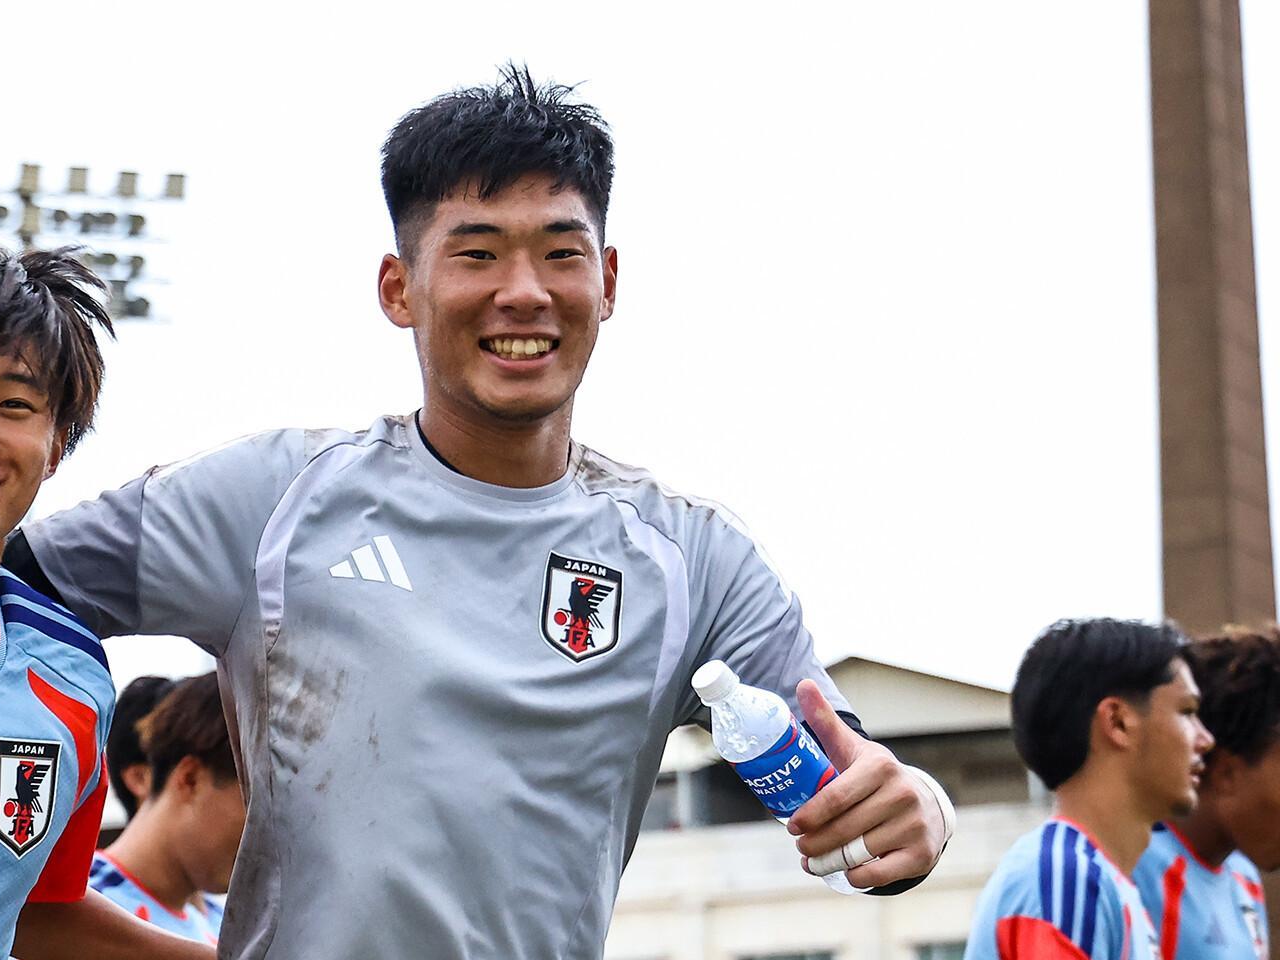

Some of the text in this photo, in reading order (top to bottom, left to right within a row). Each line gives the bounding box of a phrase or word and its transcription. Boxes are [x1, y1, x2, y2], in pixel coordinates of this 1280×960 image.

[564, 561, 607, 577] JAPAN
[560, 628, 596, 648] JFA
[11, 744, 45, 755] JAPAN
[744, 754, 802, 788] ACTIVE
[754, 778, 795, 796] WATER
[8, 818, 34, 836] JFA
